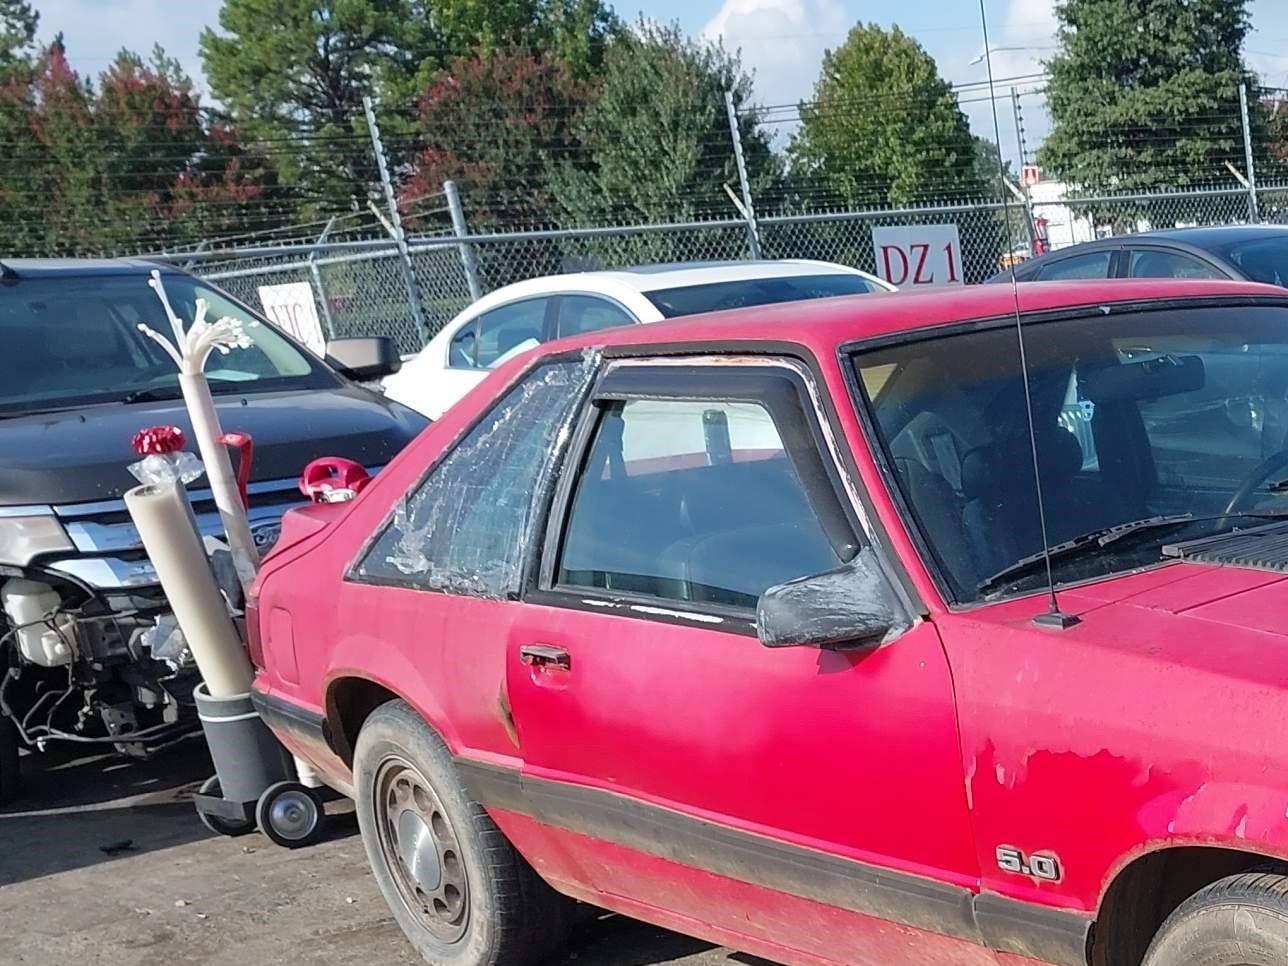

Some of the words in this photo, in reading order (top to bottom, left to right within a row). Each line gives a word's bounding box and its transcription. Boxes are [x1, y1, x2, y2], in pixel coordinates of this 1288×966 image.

[880, 244, 935, 286] DZ
[944, 241, 959, 283] 1
[995, 847, 1060, 880] 5.0
